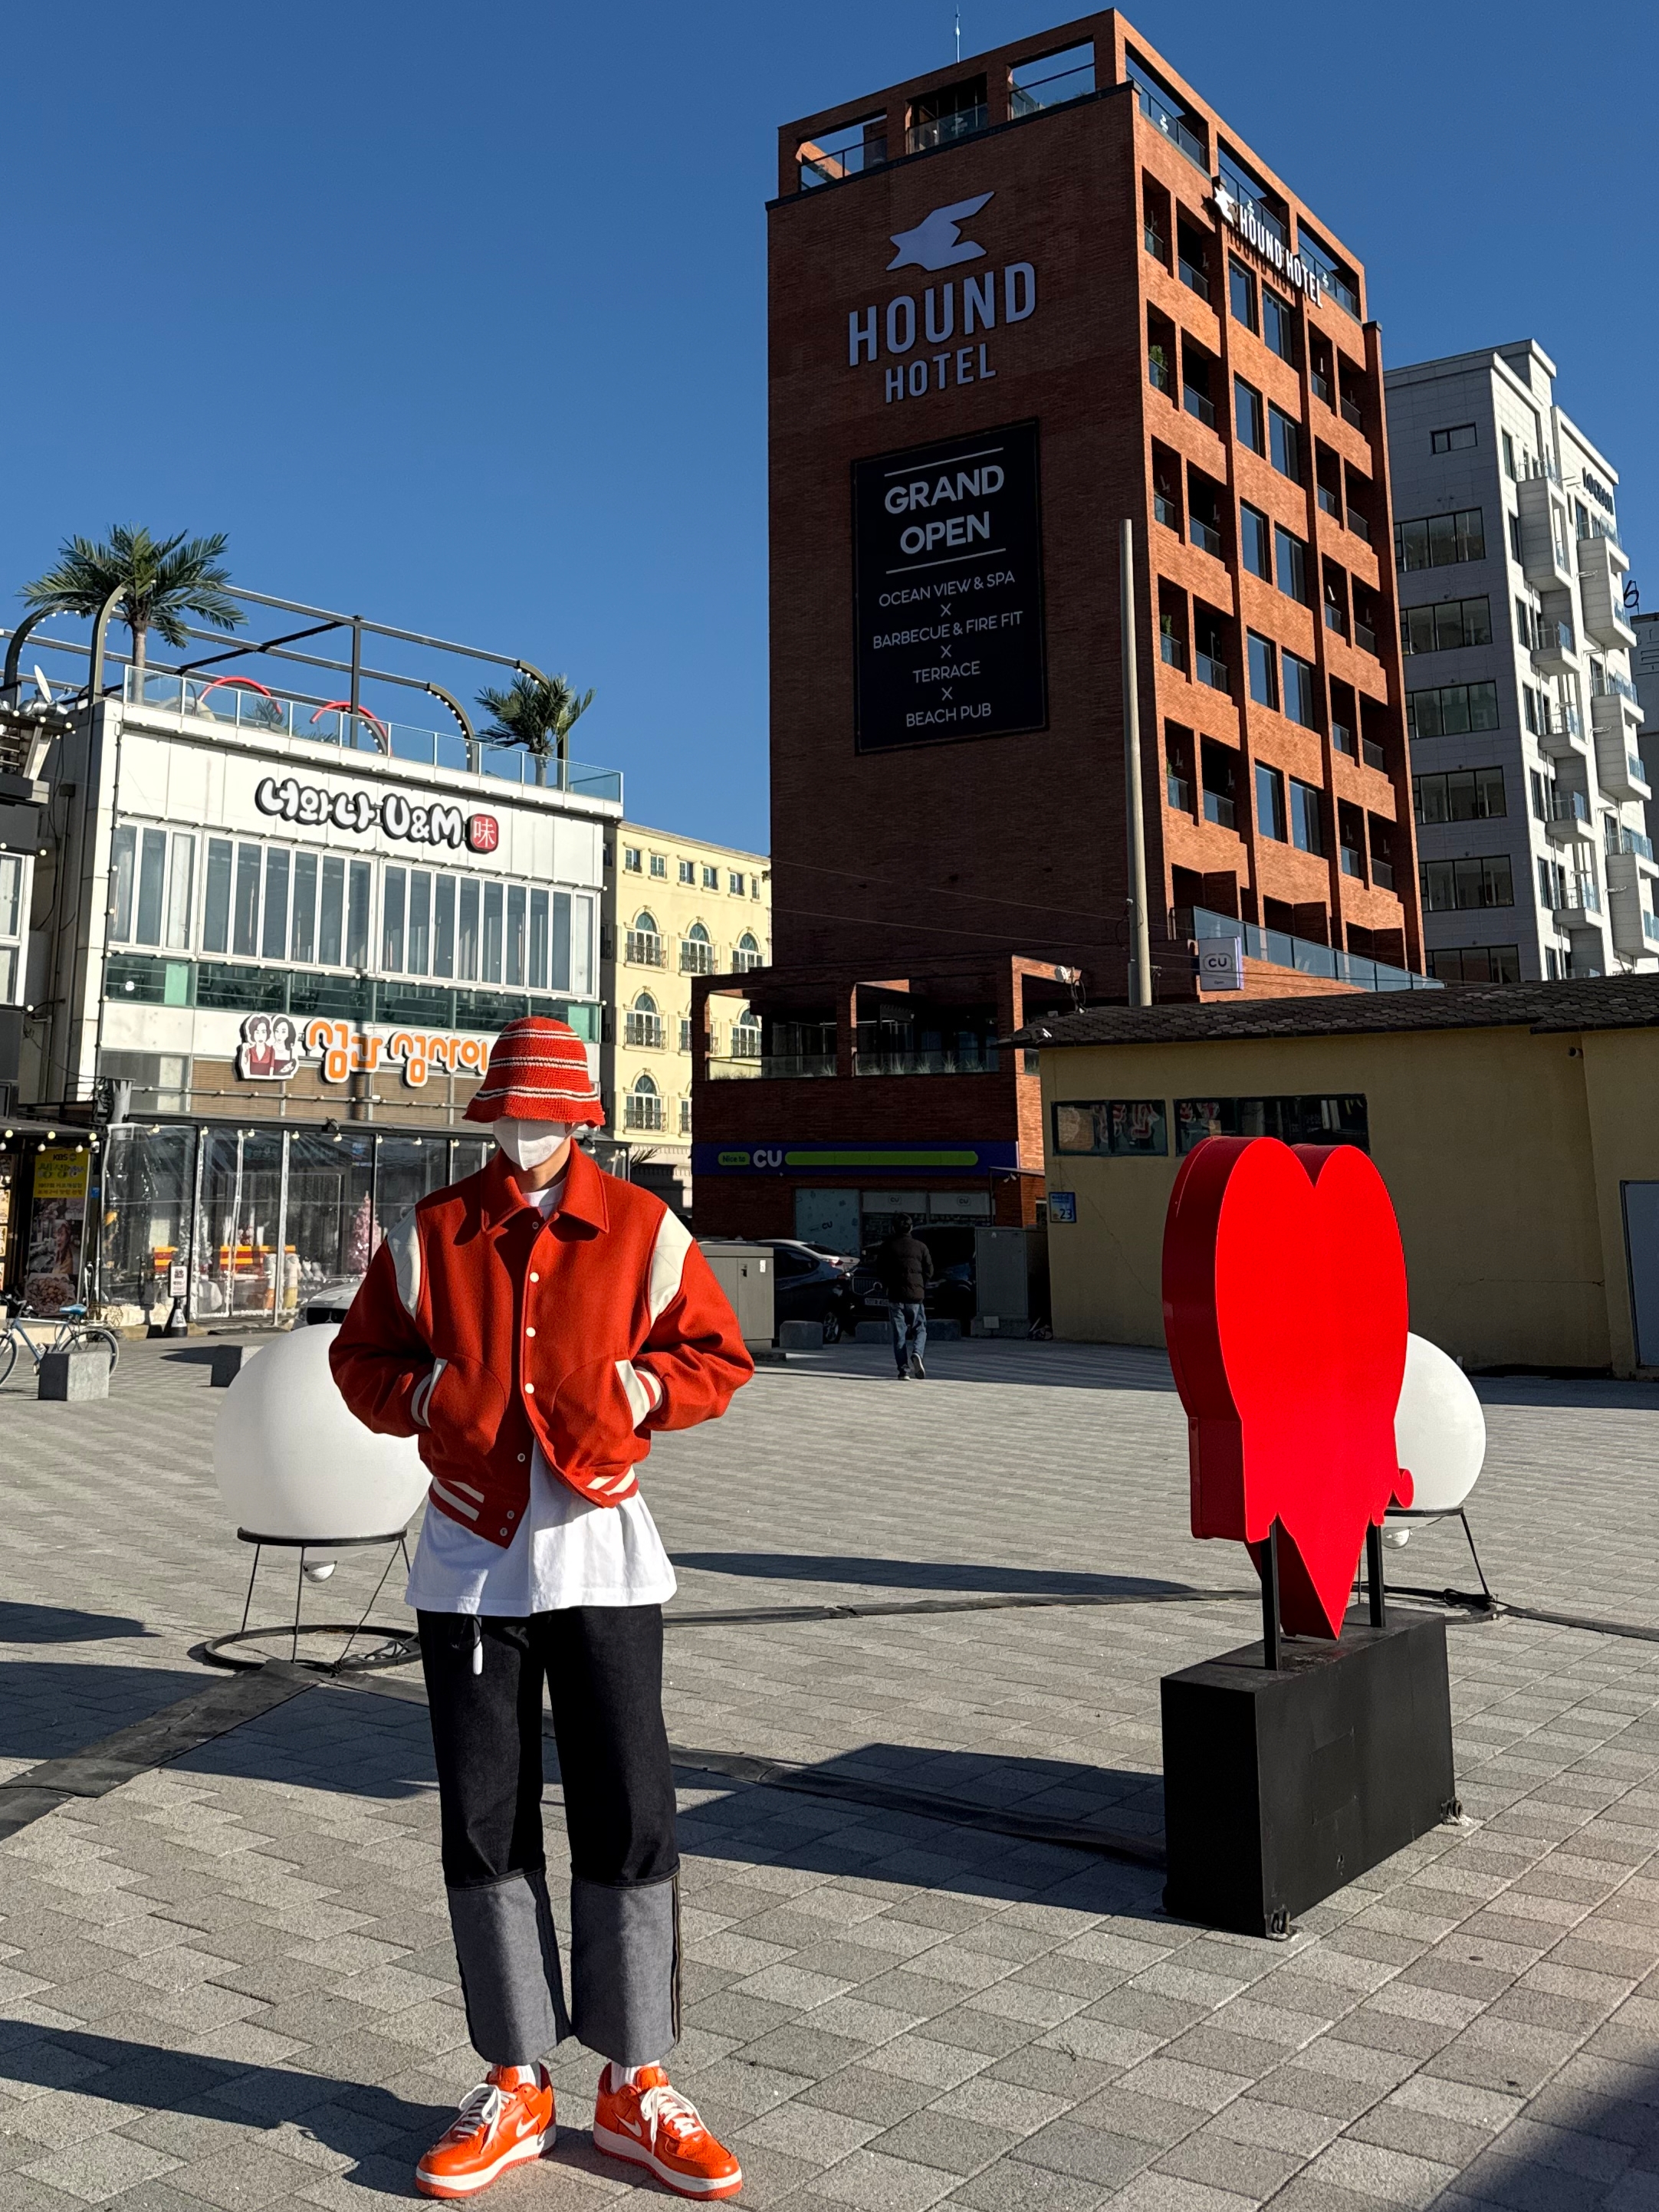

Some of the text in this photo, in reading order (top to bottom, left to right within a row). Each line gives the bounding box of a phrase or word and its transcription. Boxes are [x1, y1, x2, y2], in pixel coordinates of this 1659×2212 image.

[1240, 204, 1323, 309] HOUND HOTEL
[849, 261, 1036, 366] HOUND
[885, 343, 997, 403] HOTEL
[884, 464, 1005, 514] GRAND
[899, 511, 991, 554] OPEN
[879, 570, 1015, 607] OCEAN VIEW & SPA
[872, 611, 1023, 649] BARBECUE & FIRE FIT
[912, 661, 981, 684] TERRACE
[905, 702, 991, 727] BEACH PUB
[257, 777, 378, 832] 너와나
[384, 793, 463, 848] U&M
[1208, 957, 1227, 967] CU
[753, 1149, 783, 1168] CU
[821, 1221, 833, 1229] CU
[1059, 1209, 1073, 1219] 23
